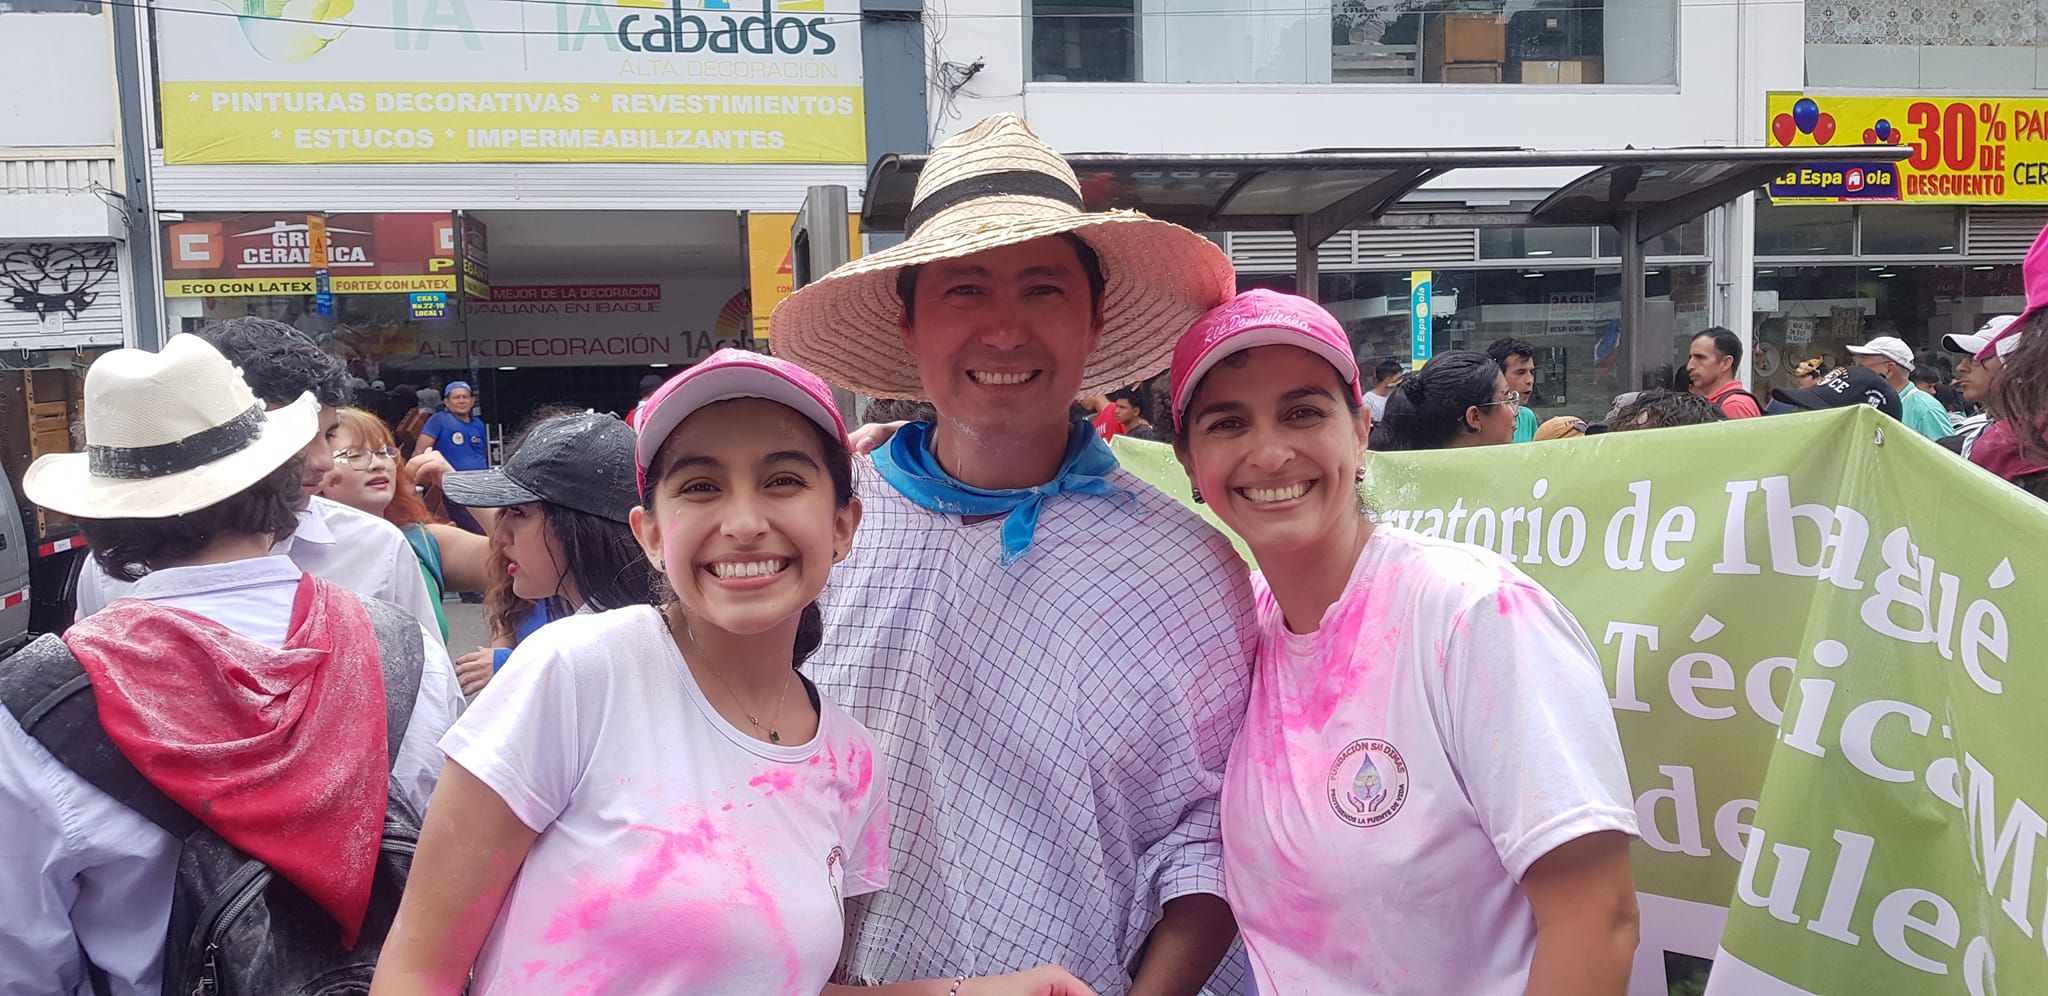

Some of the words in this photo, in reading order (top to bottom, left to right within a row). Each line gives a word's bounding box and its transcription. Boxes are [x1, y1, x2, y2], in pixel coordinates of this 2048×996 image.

[619, 58, 678, 77] ALTA
[687, 58, 838, 79] DECORACIÓN
[211, 91, 366, 113] PINTURAS
[376, 92, 579, 113] DECORATIVAS
[611, 93, 854, 116] REVESTIMIENTOS
[294, 127, 434, 149] ESTUCOS
[467, 128, 785, 150] IMPERMEABILIZANTES
[1906, 101, 2007, 171] 30%
[1980, 145, 2006, 171] DE
[1906, 174, 2005, 196] DESCUENTO
[182, 284, 216, 294] ECO
[220, 283, 254, 293] CON
[259, 282, 312, 292] LATEX
[336, 281, 382, 291] FORTEX
[384, 280, 409, 291] CON
[411, 279, 449, 290] LATEX
[493, 288, 537, 299] MEJOR
[541, 289, 557, 298] DE
[561, 289, 577, 298] LA
[414, 309, 437, 317] LOCAL
[564, 303, 589, 313] EN
[495, 333, 670, 357] DECORACIÓN
[1603, 479, 1696, 572] de
[1712, 475, 2016, 695] Ibagué
[1383, 746, 1405, 774] DIMAS
[1366, 810, 1392, 824] FUENTE
[1391, 801, 1400, 812] DE
[1397, 783, 1405, 802] VIDA
[1635, 764, 1761, 863] de
